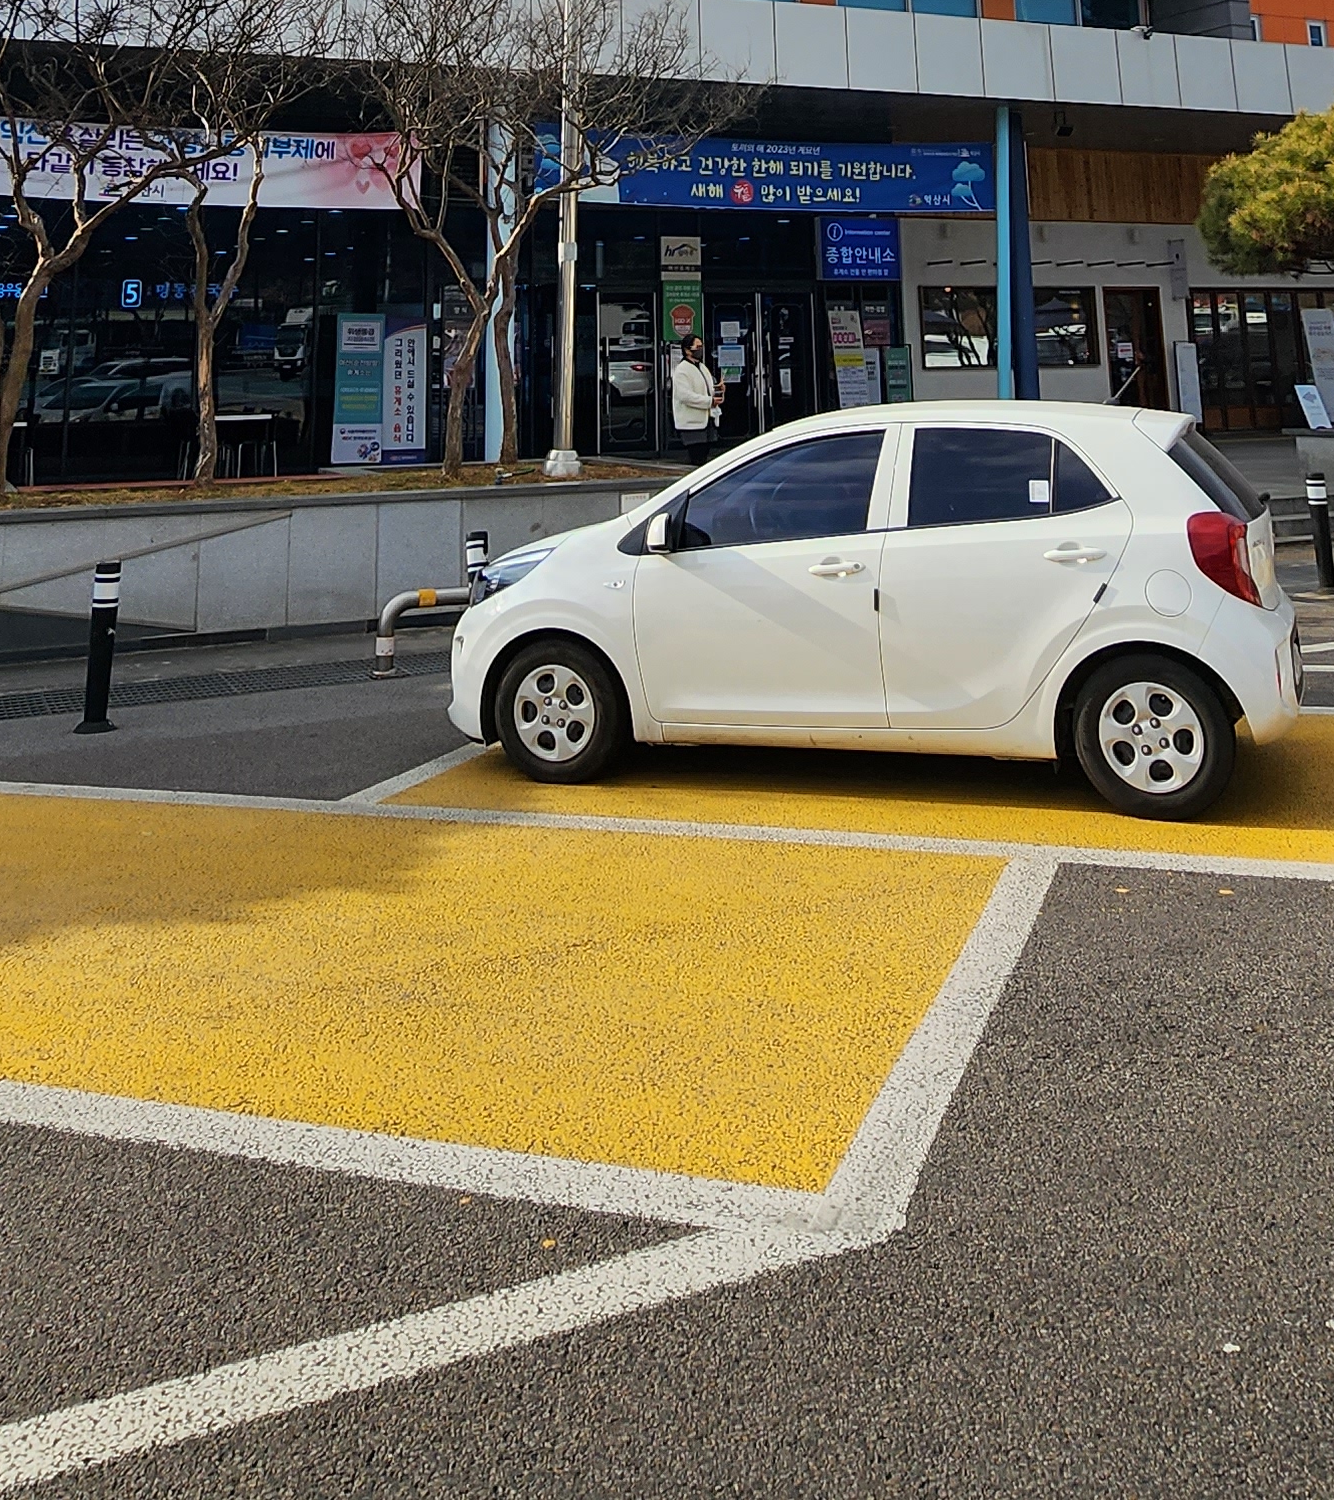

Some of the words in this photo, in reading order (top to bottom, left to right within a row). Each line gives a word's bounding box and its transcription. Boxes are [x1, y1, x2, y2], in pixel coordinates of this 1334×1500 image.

[766, 145, 796, 155] 2023년
[626, 152, 692, 173] 행복하고
[698, 156, 747, 177] 건강한
[752, 157, 784, 177] 한해
[789, 159, 833, 180] 되기를
[838, 161, 917, 181] 기원합니다.
[690, 183, 724, 199] 새해
[760, 185, 790, 203] 많이
[796, 185, 860, 205] 받으세요!
[923, 195, 951, 206] 익산시
[826, 246, 896, 264] 종합안내소
[125, 284, 139, 304] 5
[406, 338, 415, 366] 안에서
[406, 369, 415, 389] 드실
[393, 385, 402, 416] 휴게소
[406, 392, 415, 402] 수
